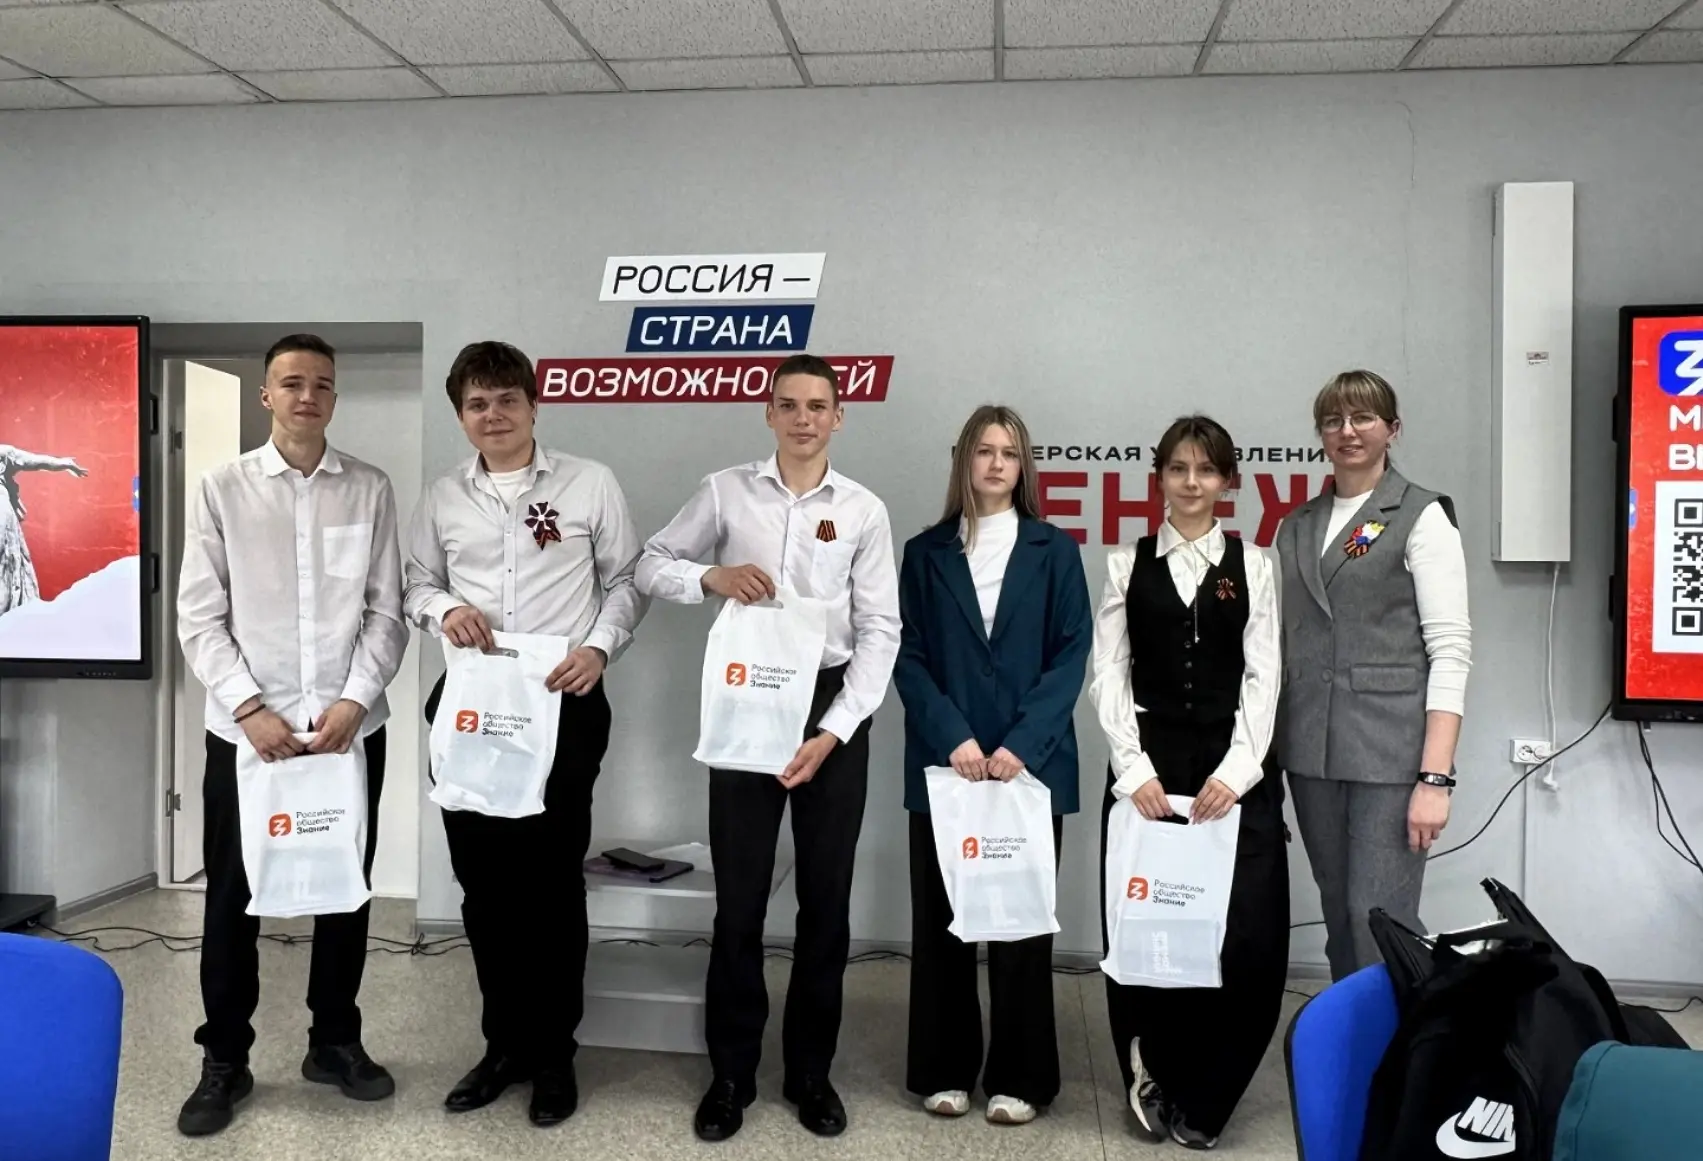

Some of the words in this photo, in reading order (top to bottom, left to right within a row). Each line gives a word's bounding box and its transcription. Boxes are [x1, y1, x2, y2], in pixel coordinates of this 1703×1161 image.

[613, 263, 774, 294] РОССИЯ
[639, 314, 793, 346] СТРАНА
[542, 360, 877, 397] ВОЗМОЖНОЙ
[751, 672, 791, 683] общество
[752, 663, 798, 675] Российское
[750, 680, 781, 690] Знание
